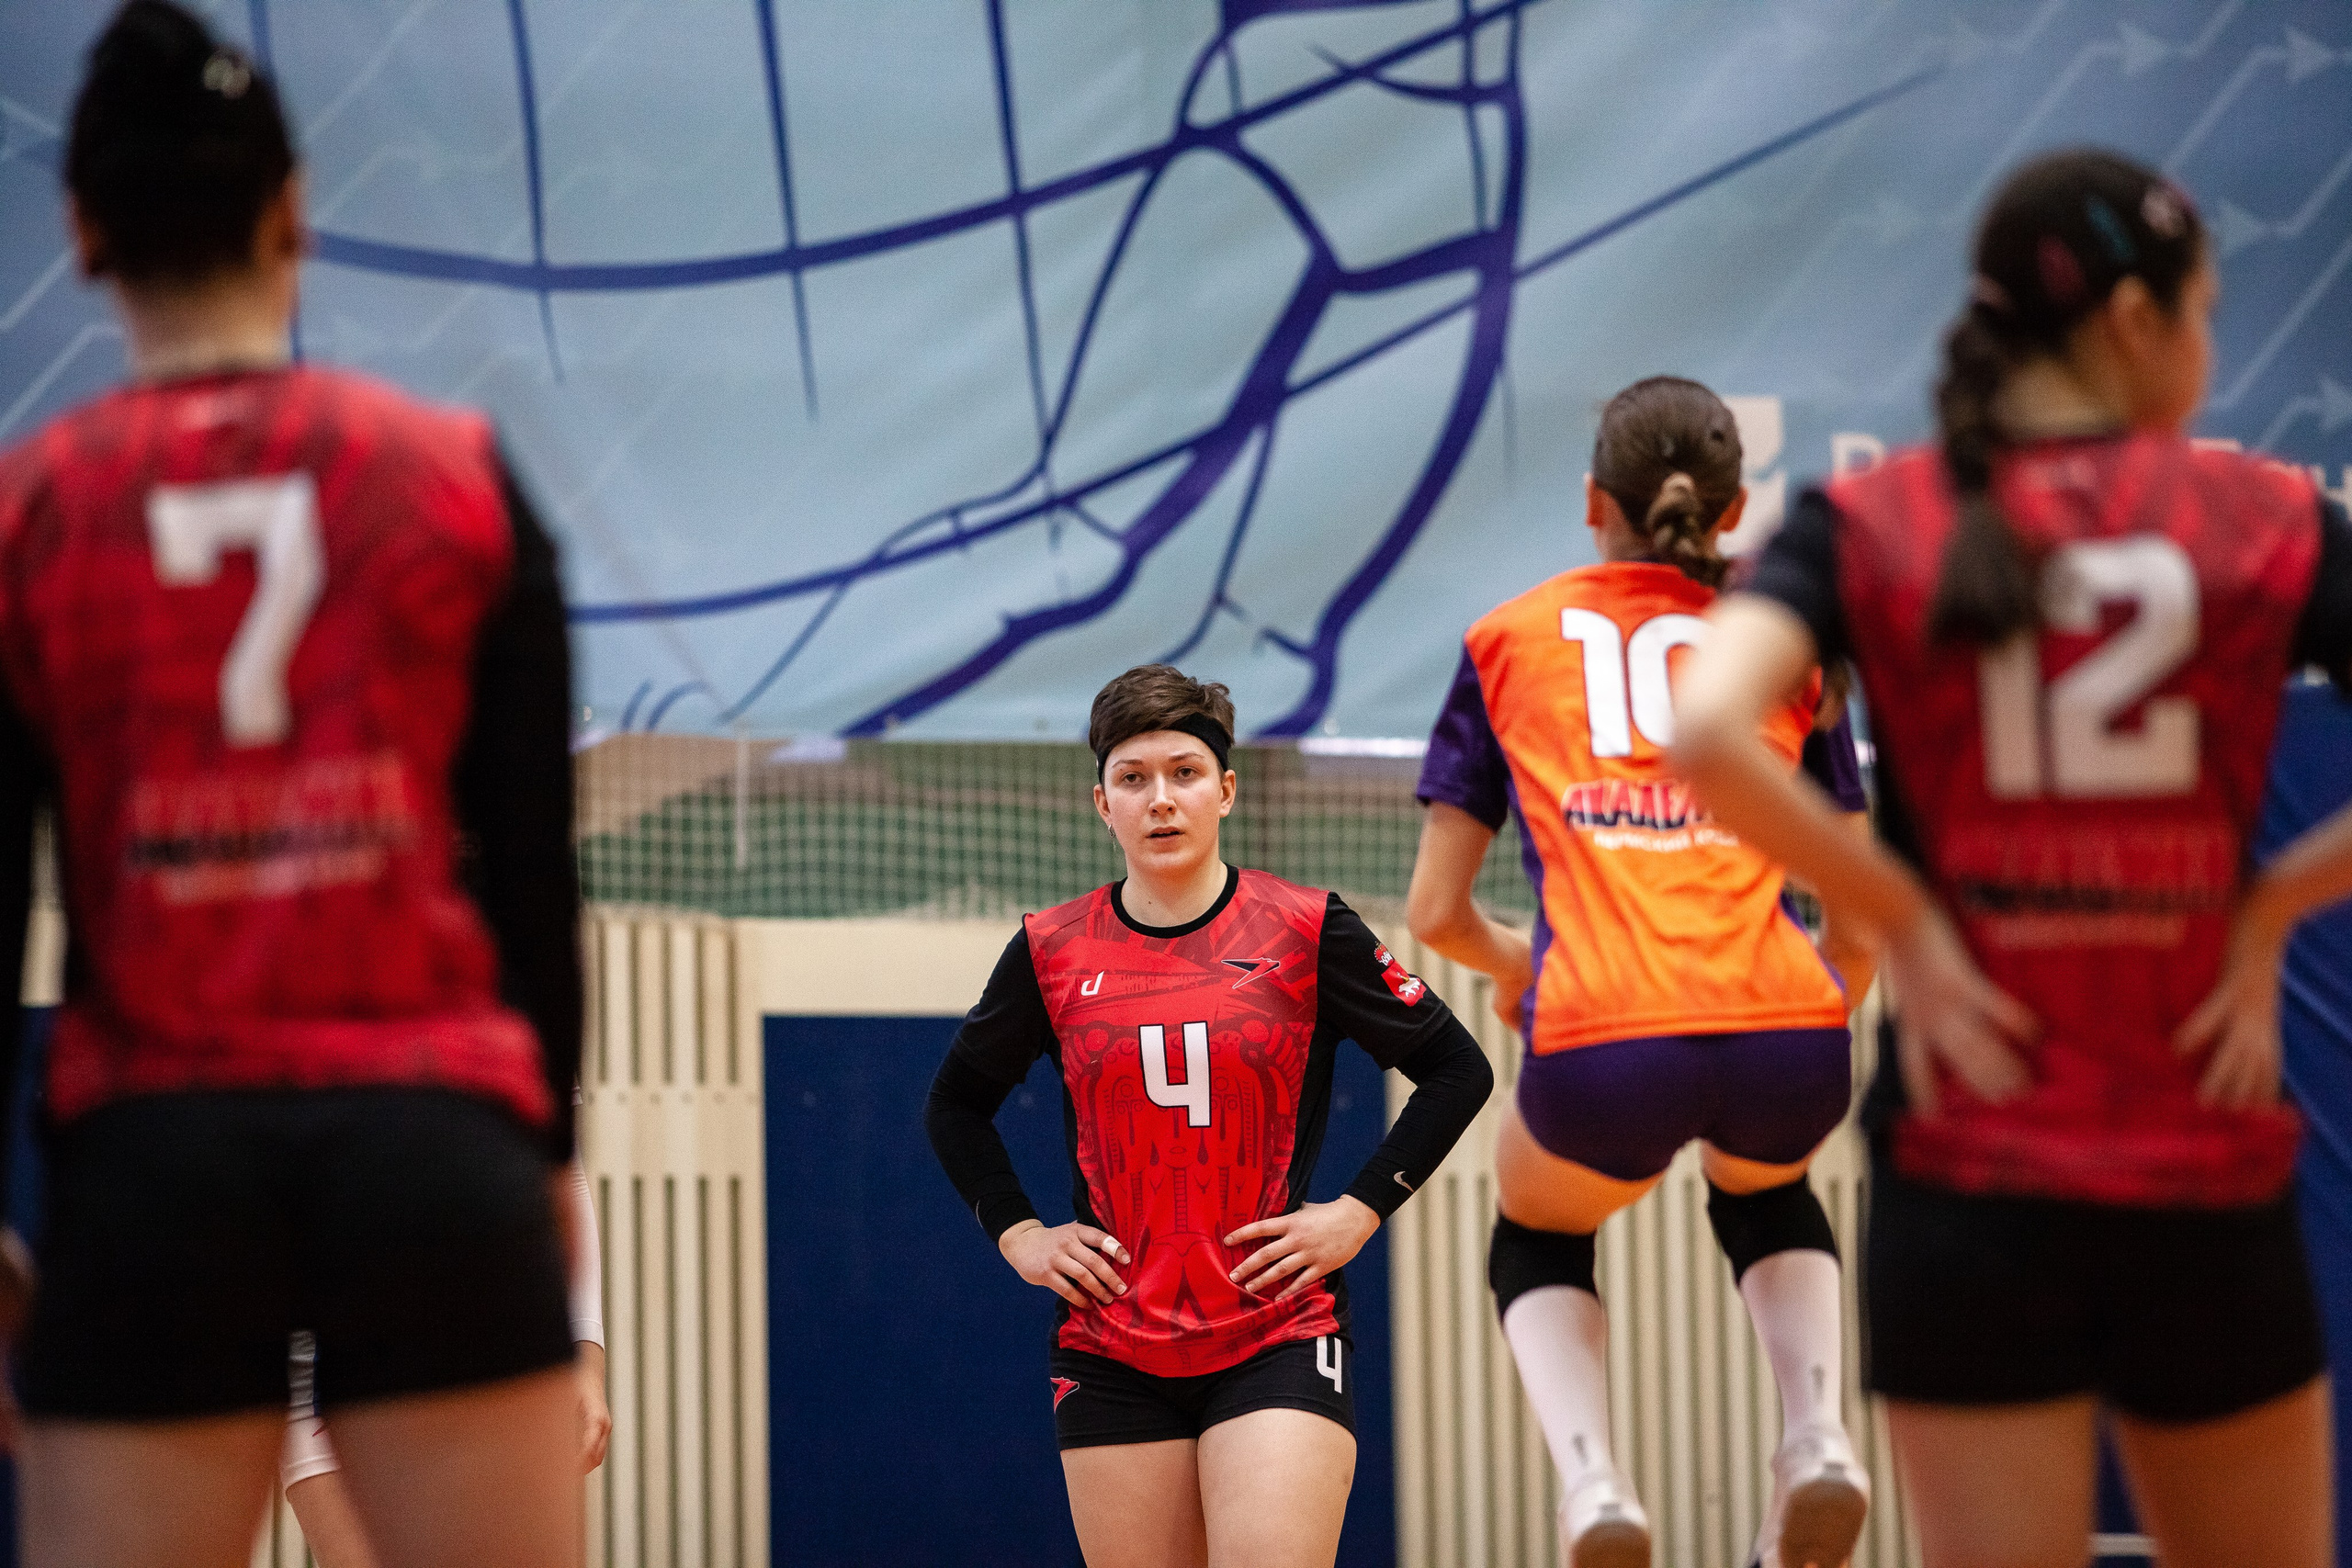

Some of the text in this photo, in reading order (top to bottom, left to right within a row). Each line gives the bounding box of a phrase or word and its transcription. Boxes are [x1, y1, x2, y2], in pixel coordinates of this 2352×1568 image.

[149, 473, 326, 749] 7
[1978, 531, 2199, 797] 12
[1138, 1021, 1212, 1128] 4
[1316, 1335, 1342, 1393] 4
